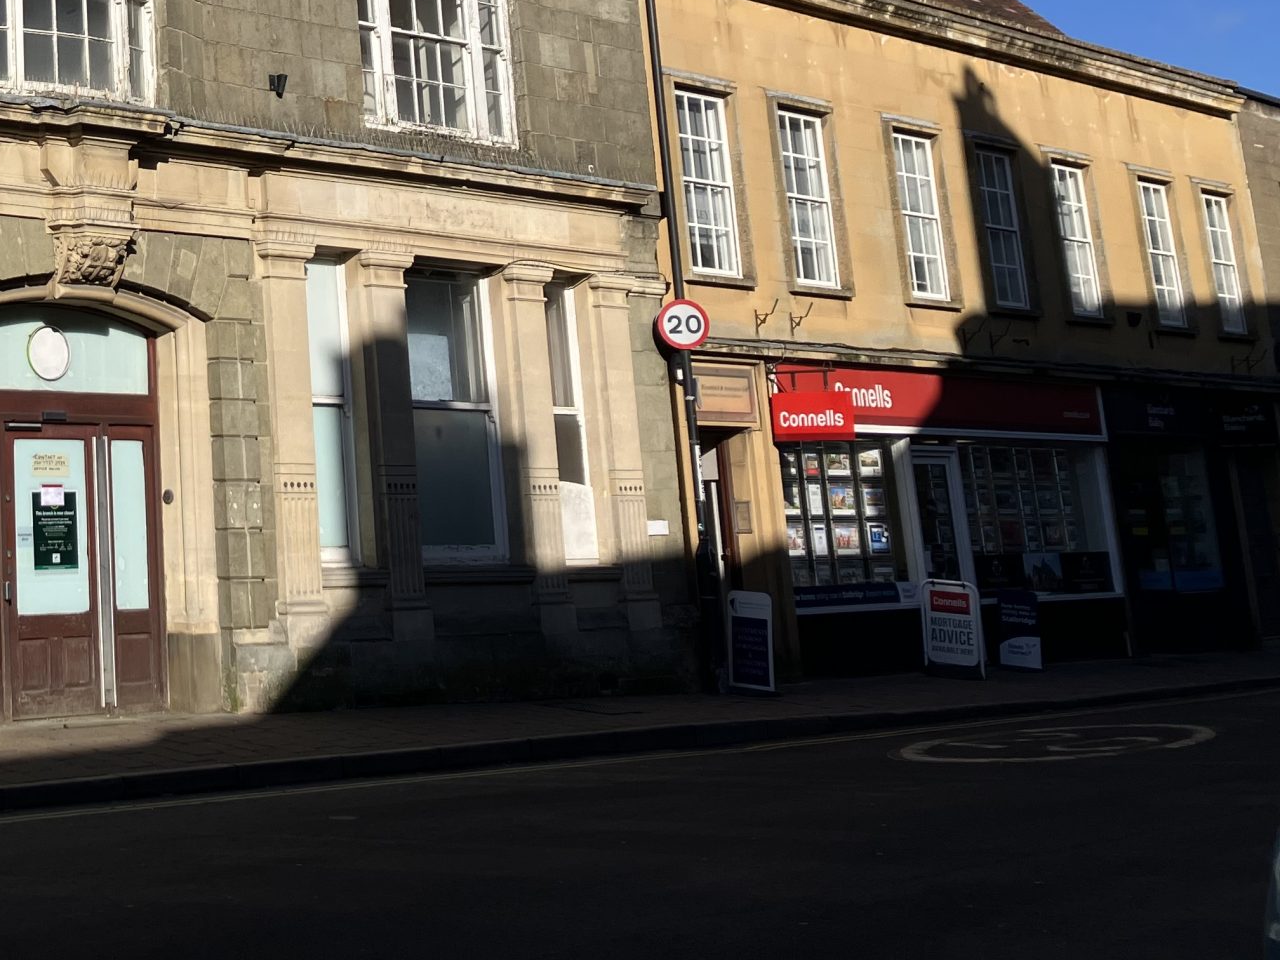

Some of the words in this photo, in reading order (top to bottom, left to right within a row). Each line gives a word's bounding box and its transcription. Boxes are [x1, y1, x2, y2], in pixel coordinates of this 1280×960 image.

[667, 314, 702, 334] 20
[834, 381, 893, 409] nnells
[779, 409, 844, 428] Connells
[933, 595, 968, 608] Connells
[930, 615, 974, 631] MORTGAGE
[930, 627, 975, 646] ADVICE
